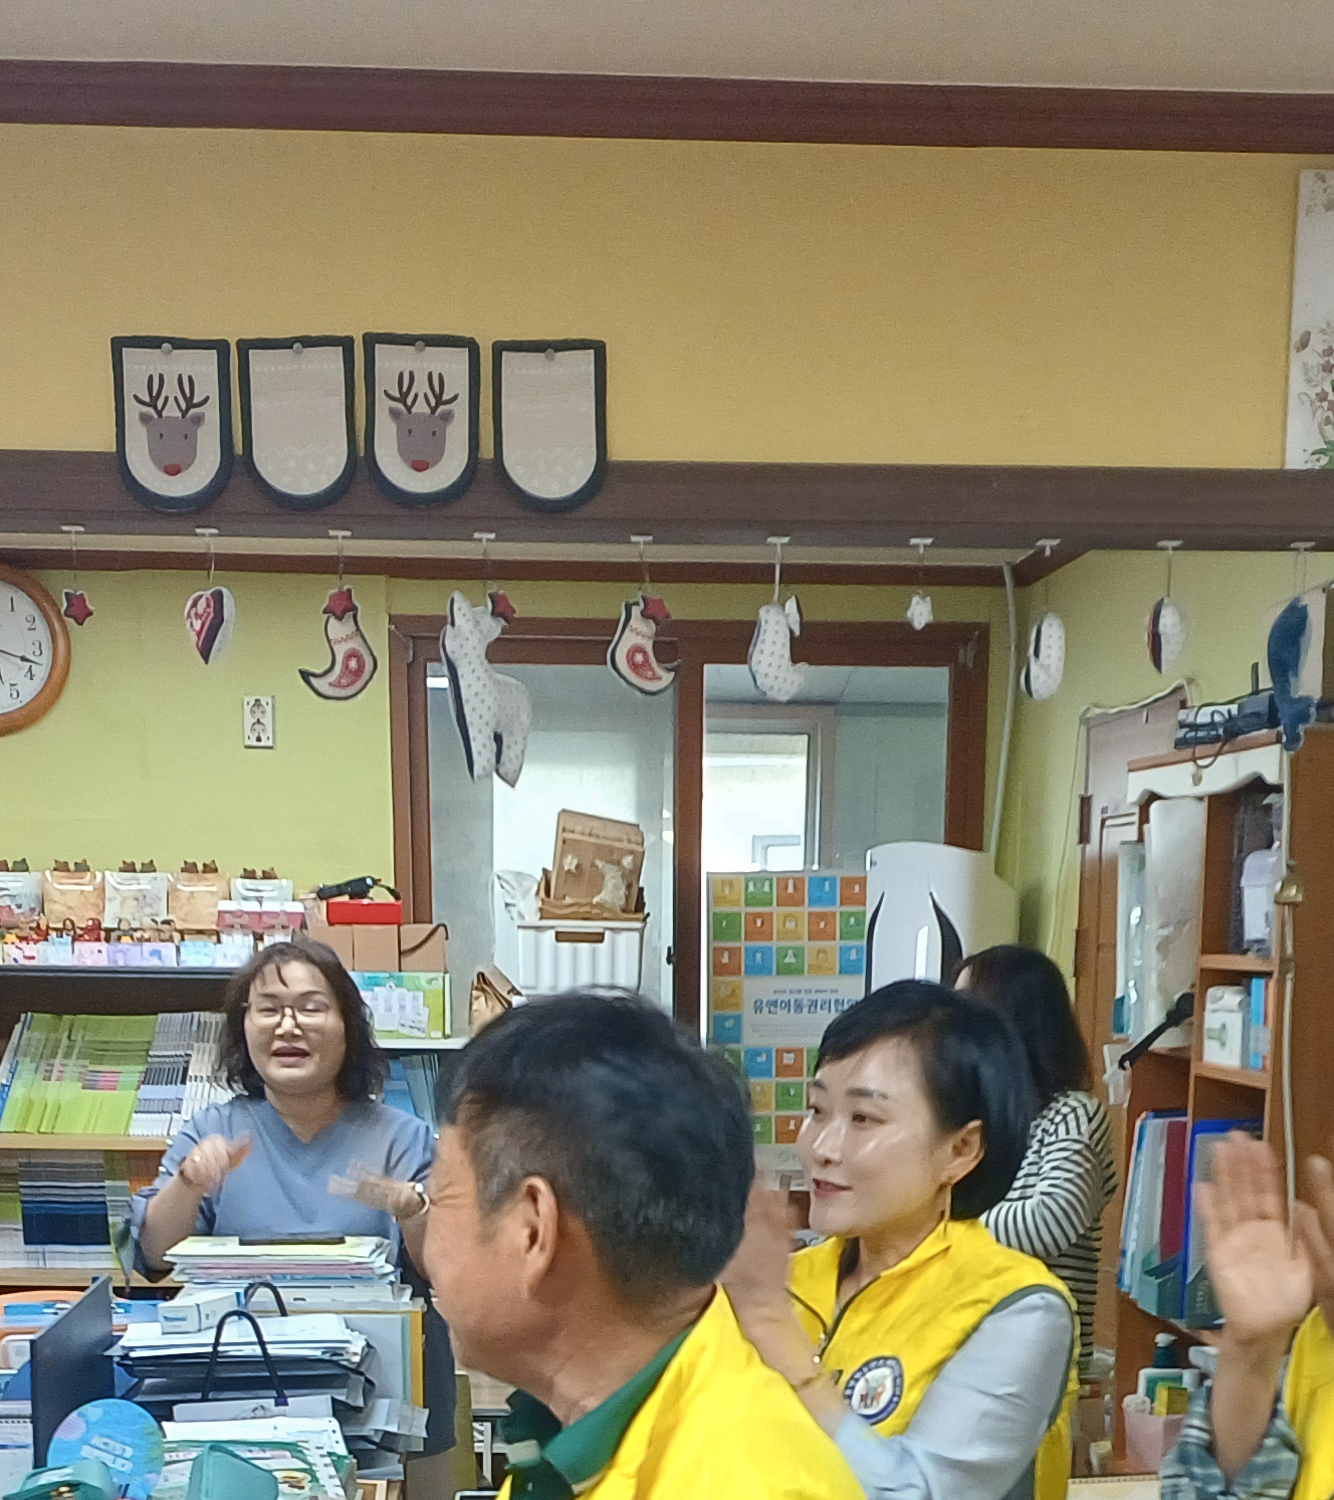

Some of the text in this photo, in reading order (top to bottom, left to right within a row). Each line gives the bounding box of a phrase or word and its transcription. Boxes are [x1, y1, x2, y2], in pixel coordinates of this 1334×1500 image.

[9, 596, 16, 612] 1
[25, 614, 37, 631] 2
[31, 640, 43, 657] 3
[24, 664, 36, 681] 4
[9, 683, 20, 700] 5
